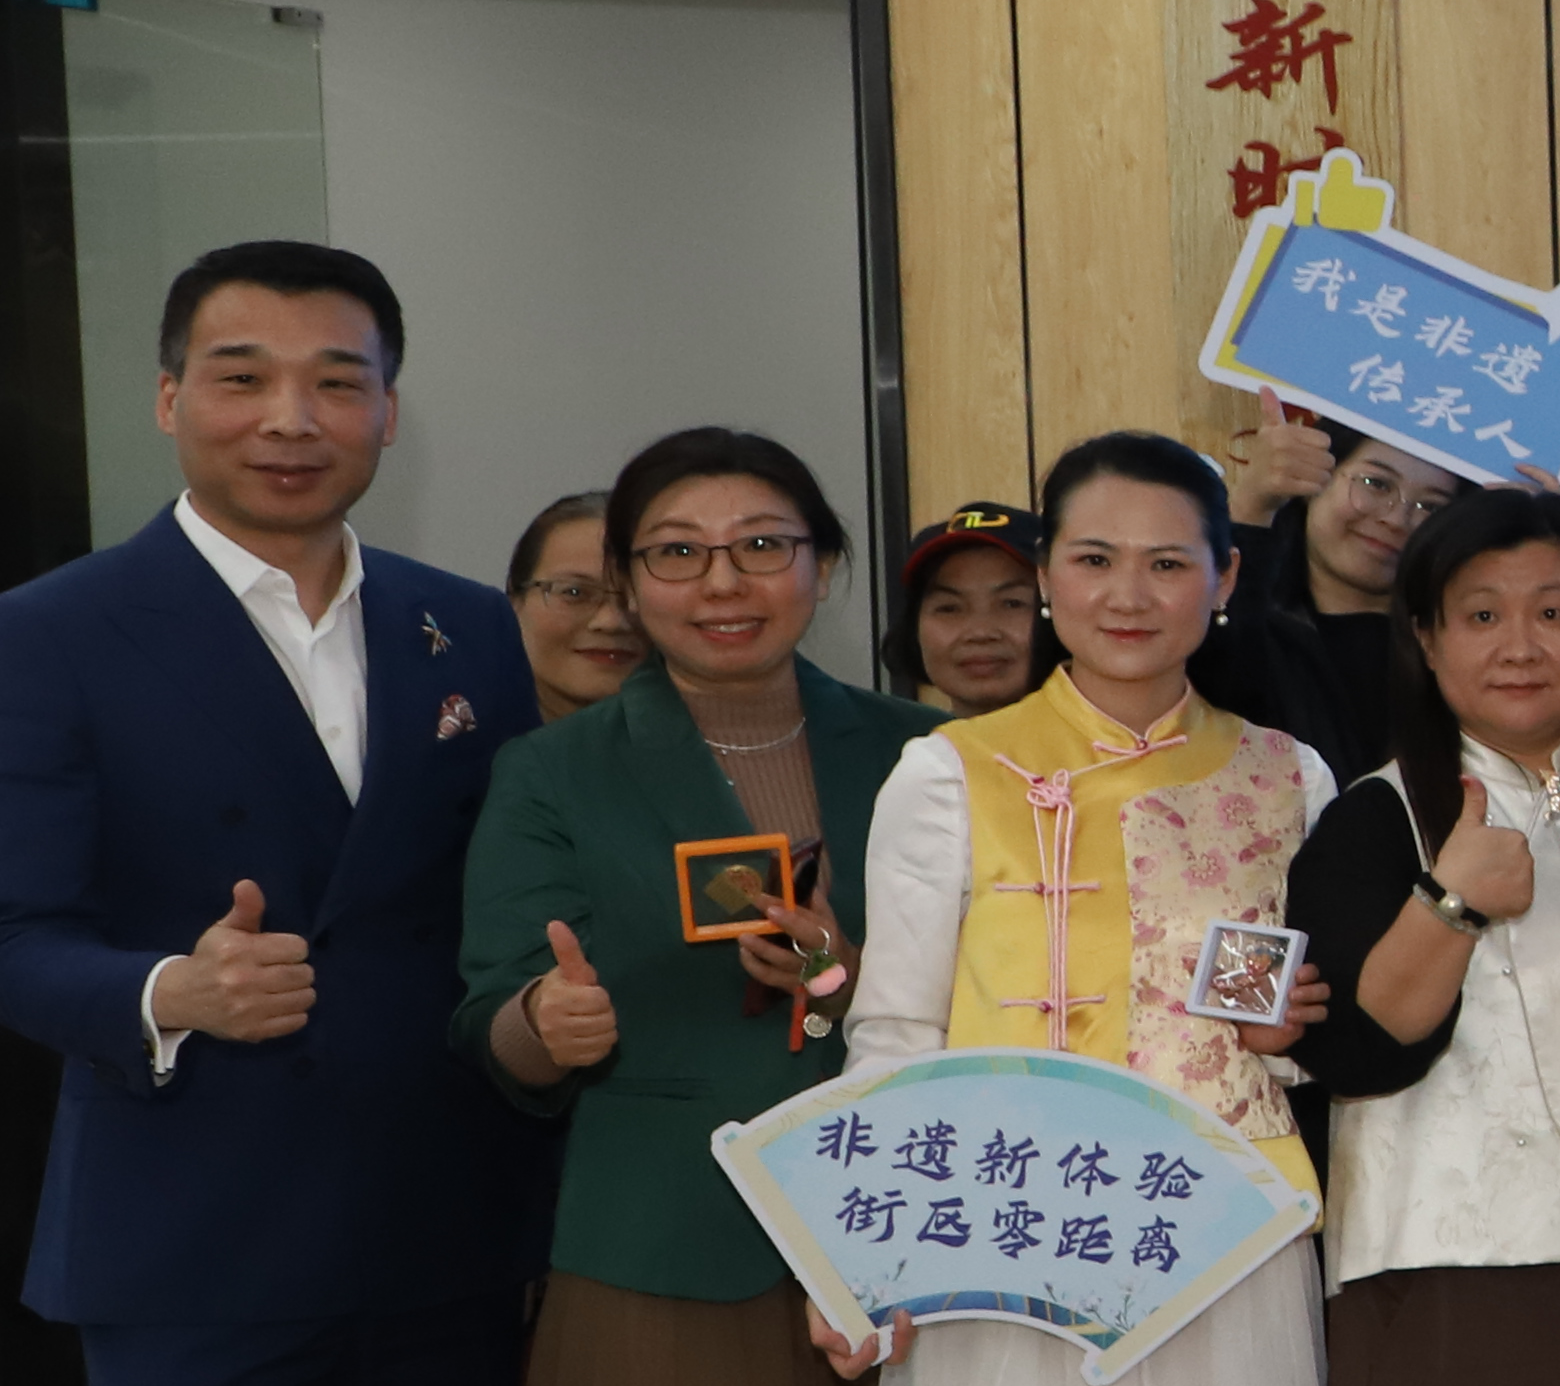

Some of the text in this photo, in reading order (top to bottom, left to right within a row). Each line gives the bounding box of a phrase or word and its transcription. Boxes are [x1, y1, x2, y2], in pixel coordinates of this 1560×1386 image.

[1291, 258, 1544, 396] 我是非遗
[1348, 353, 1533, 459] 传承人
[814, 1110, 1206, 1203] 非遗新体验
[835, 1185, 1184, 1273] 街区零距离
